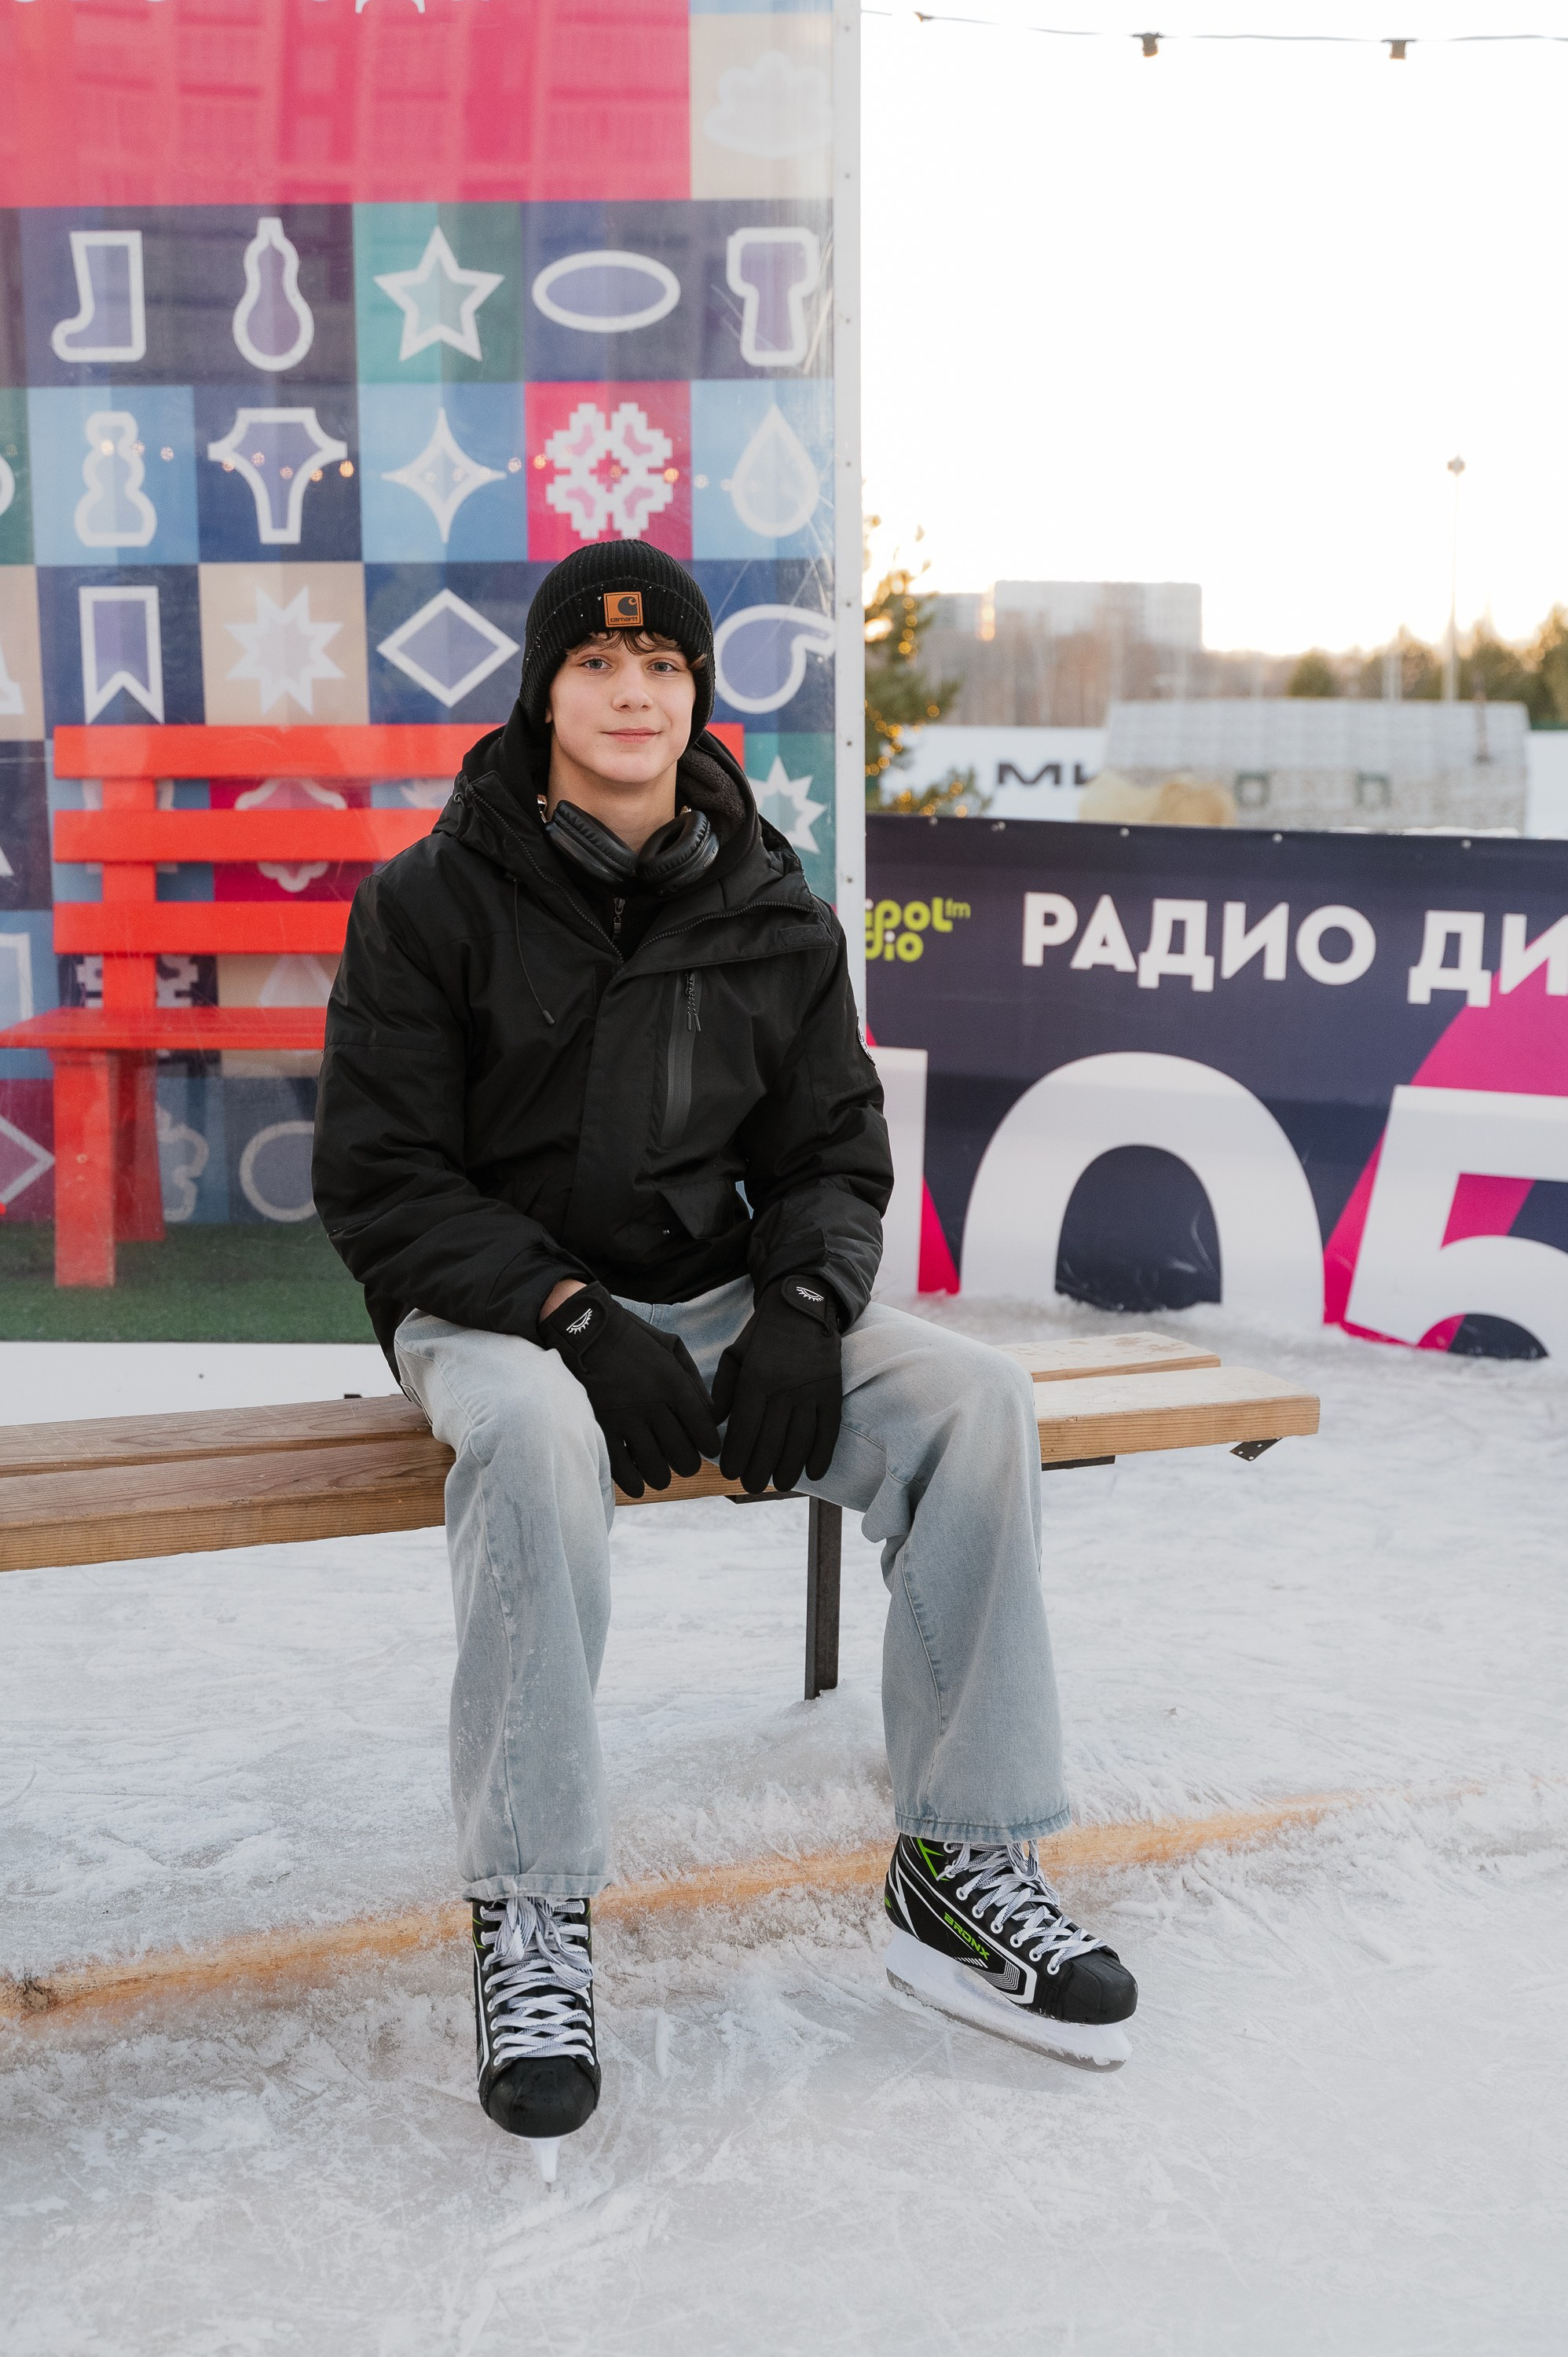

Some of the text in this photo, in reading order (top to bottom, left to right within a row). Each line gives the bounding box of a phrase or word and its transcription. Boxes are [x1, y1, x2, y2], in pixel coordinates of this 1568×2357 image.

[1022, 891, 1568, 1009] РАДИО ДИ
[943, 1912, 991, 1961] BRONX
